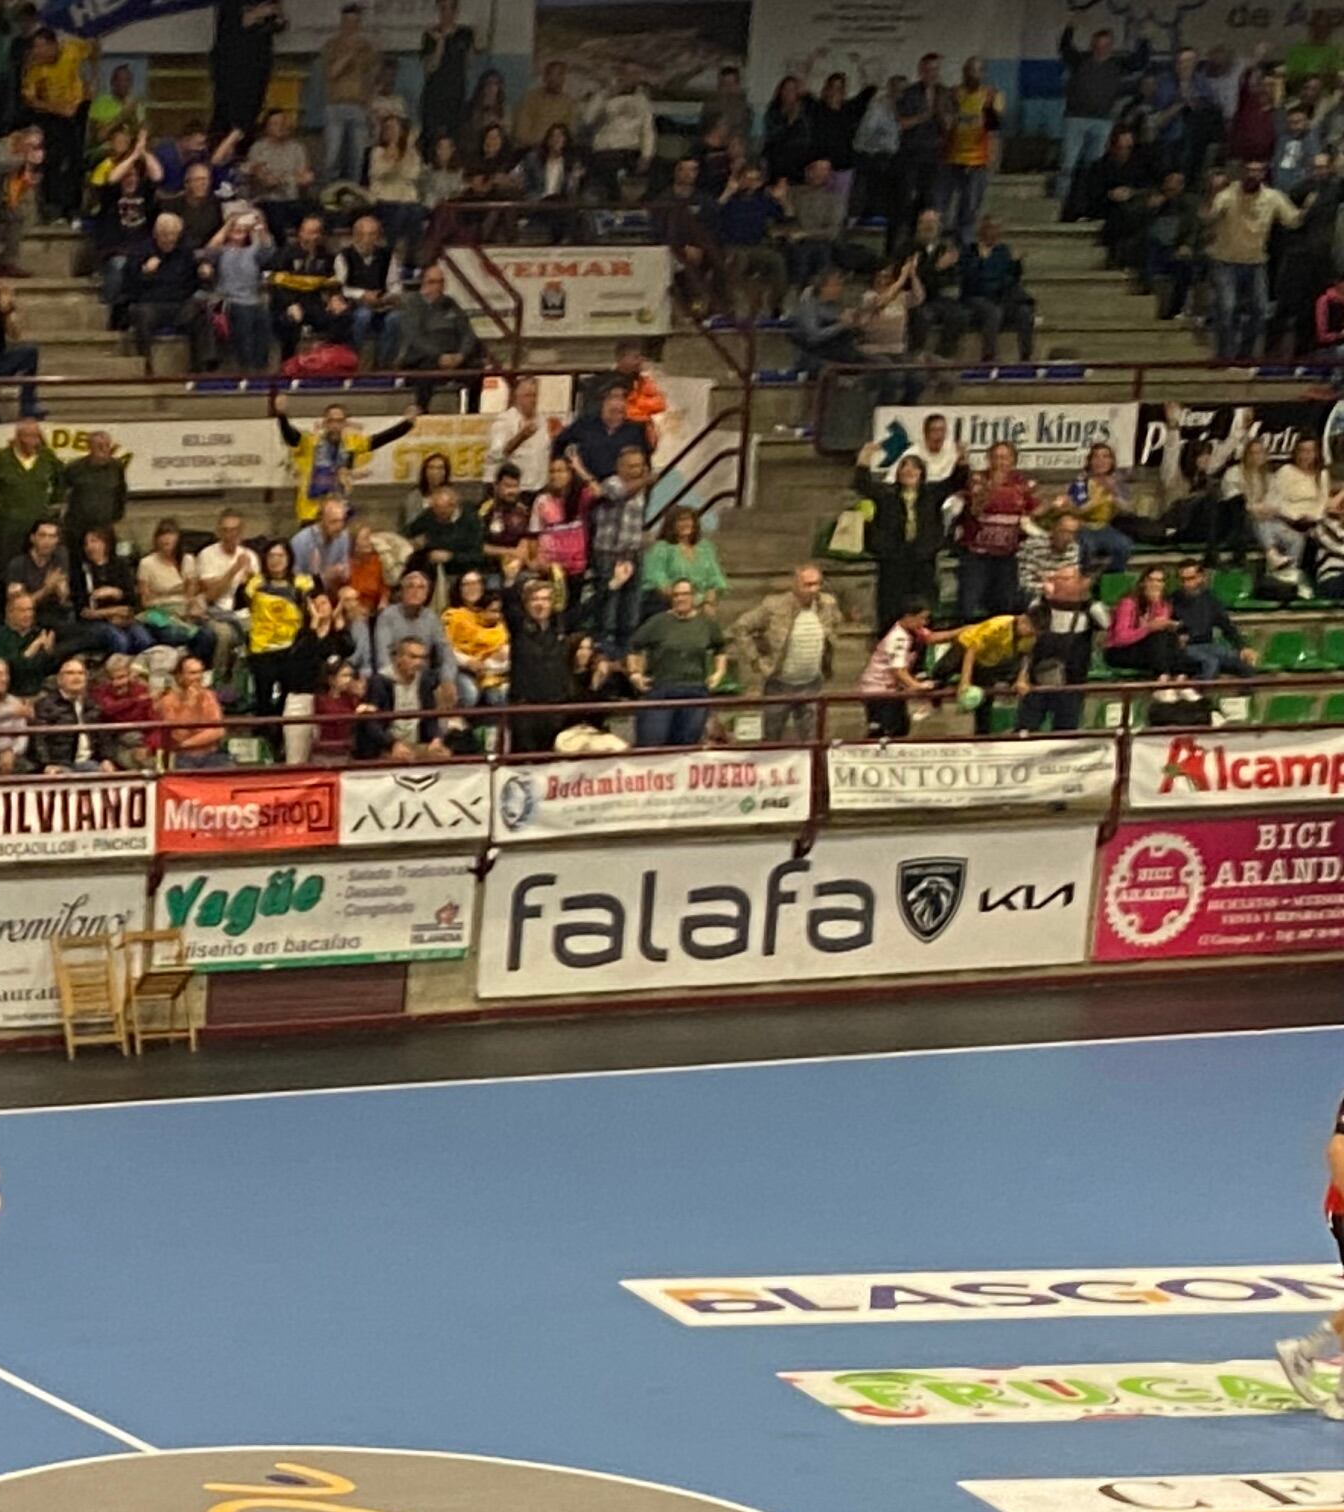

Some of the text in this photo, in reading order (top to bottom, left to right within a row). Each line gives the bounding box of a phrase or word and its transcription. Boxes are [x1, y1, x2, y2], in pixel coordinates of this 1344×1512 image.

[954, 412, 1026, 446] Little
[833, 763, 1034, 789] MONTOUTO
[350, 795, 486, 833] AJAX
[1256, 821, 1336, 851] BICI
[507, 858, 876, 972] falafa
[252, 941, 280, 956] en
[833, 1370, 1344, 1413] FRUGA
